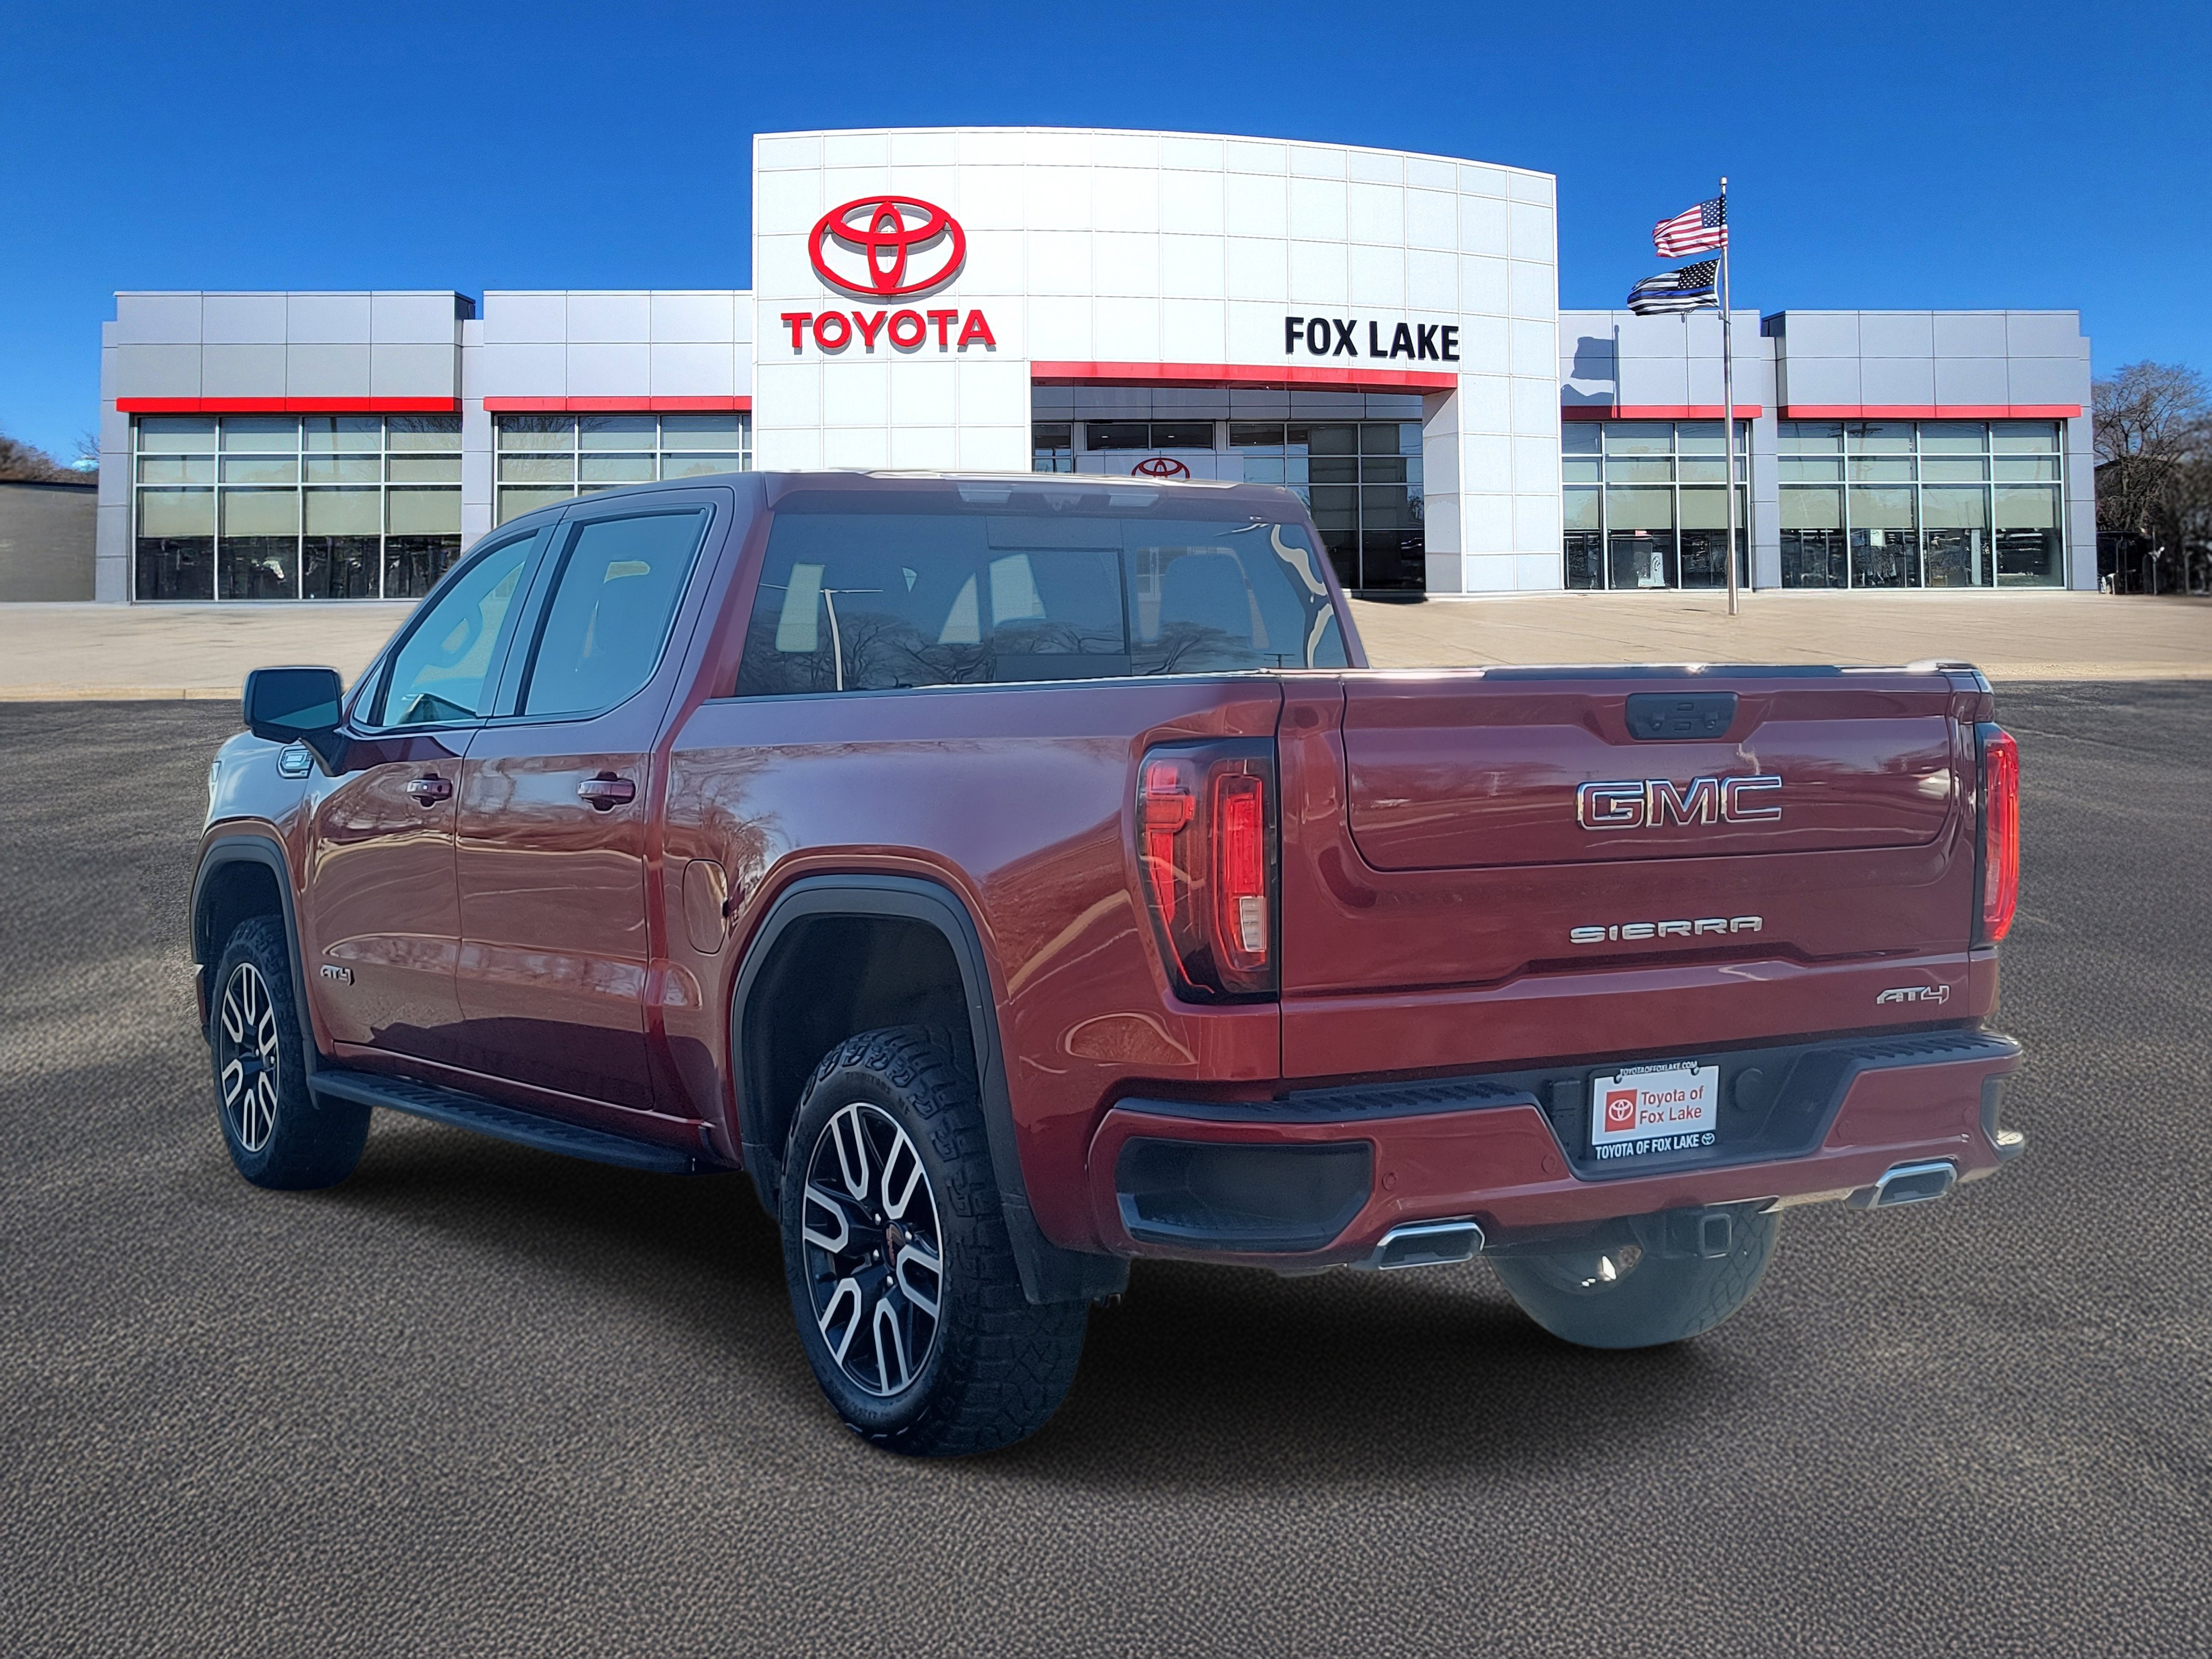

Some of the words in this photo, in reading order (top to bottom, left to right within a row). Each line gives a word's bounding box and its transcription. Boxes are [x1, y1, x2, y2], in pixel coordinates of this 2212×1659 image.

[781, 309, 996, 350] TOYOTA
[1285, 317, 1358, 356] FOX
[1369, 321, 1460, 361] LAKE
[1577, 775, 1782, 830] GMC
[1570, 916, 1763, 944] SIERRA
[320, 963, 355, 986] AT4
[1876, 985, 1950, 1005] AT4
[1641, 1089, 1685, 1108] Toyota
[1690, 1085, 1704, 1099] of
[1639, 1110, 1664, 1124] Fox
[1669, 1105, 1702, 1121] Lake
[1595, 1143, 1634, 1159] TOYOTA
[1637, 1141, 1650, 1154] OF
[1652, 1138, 1672, 1152] FOX
[1674, 1133, 1699, 1150] LAKE
